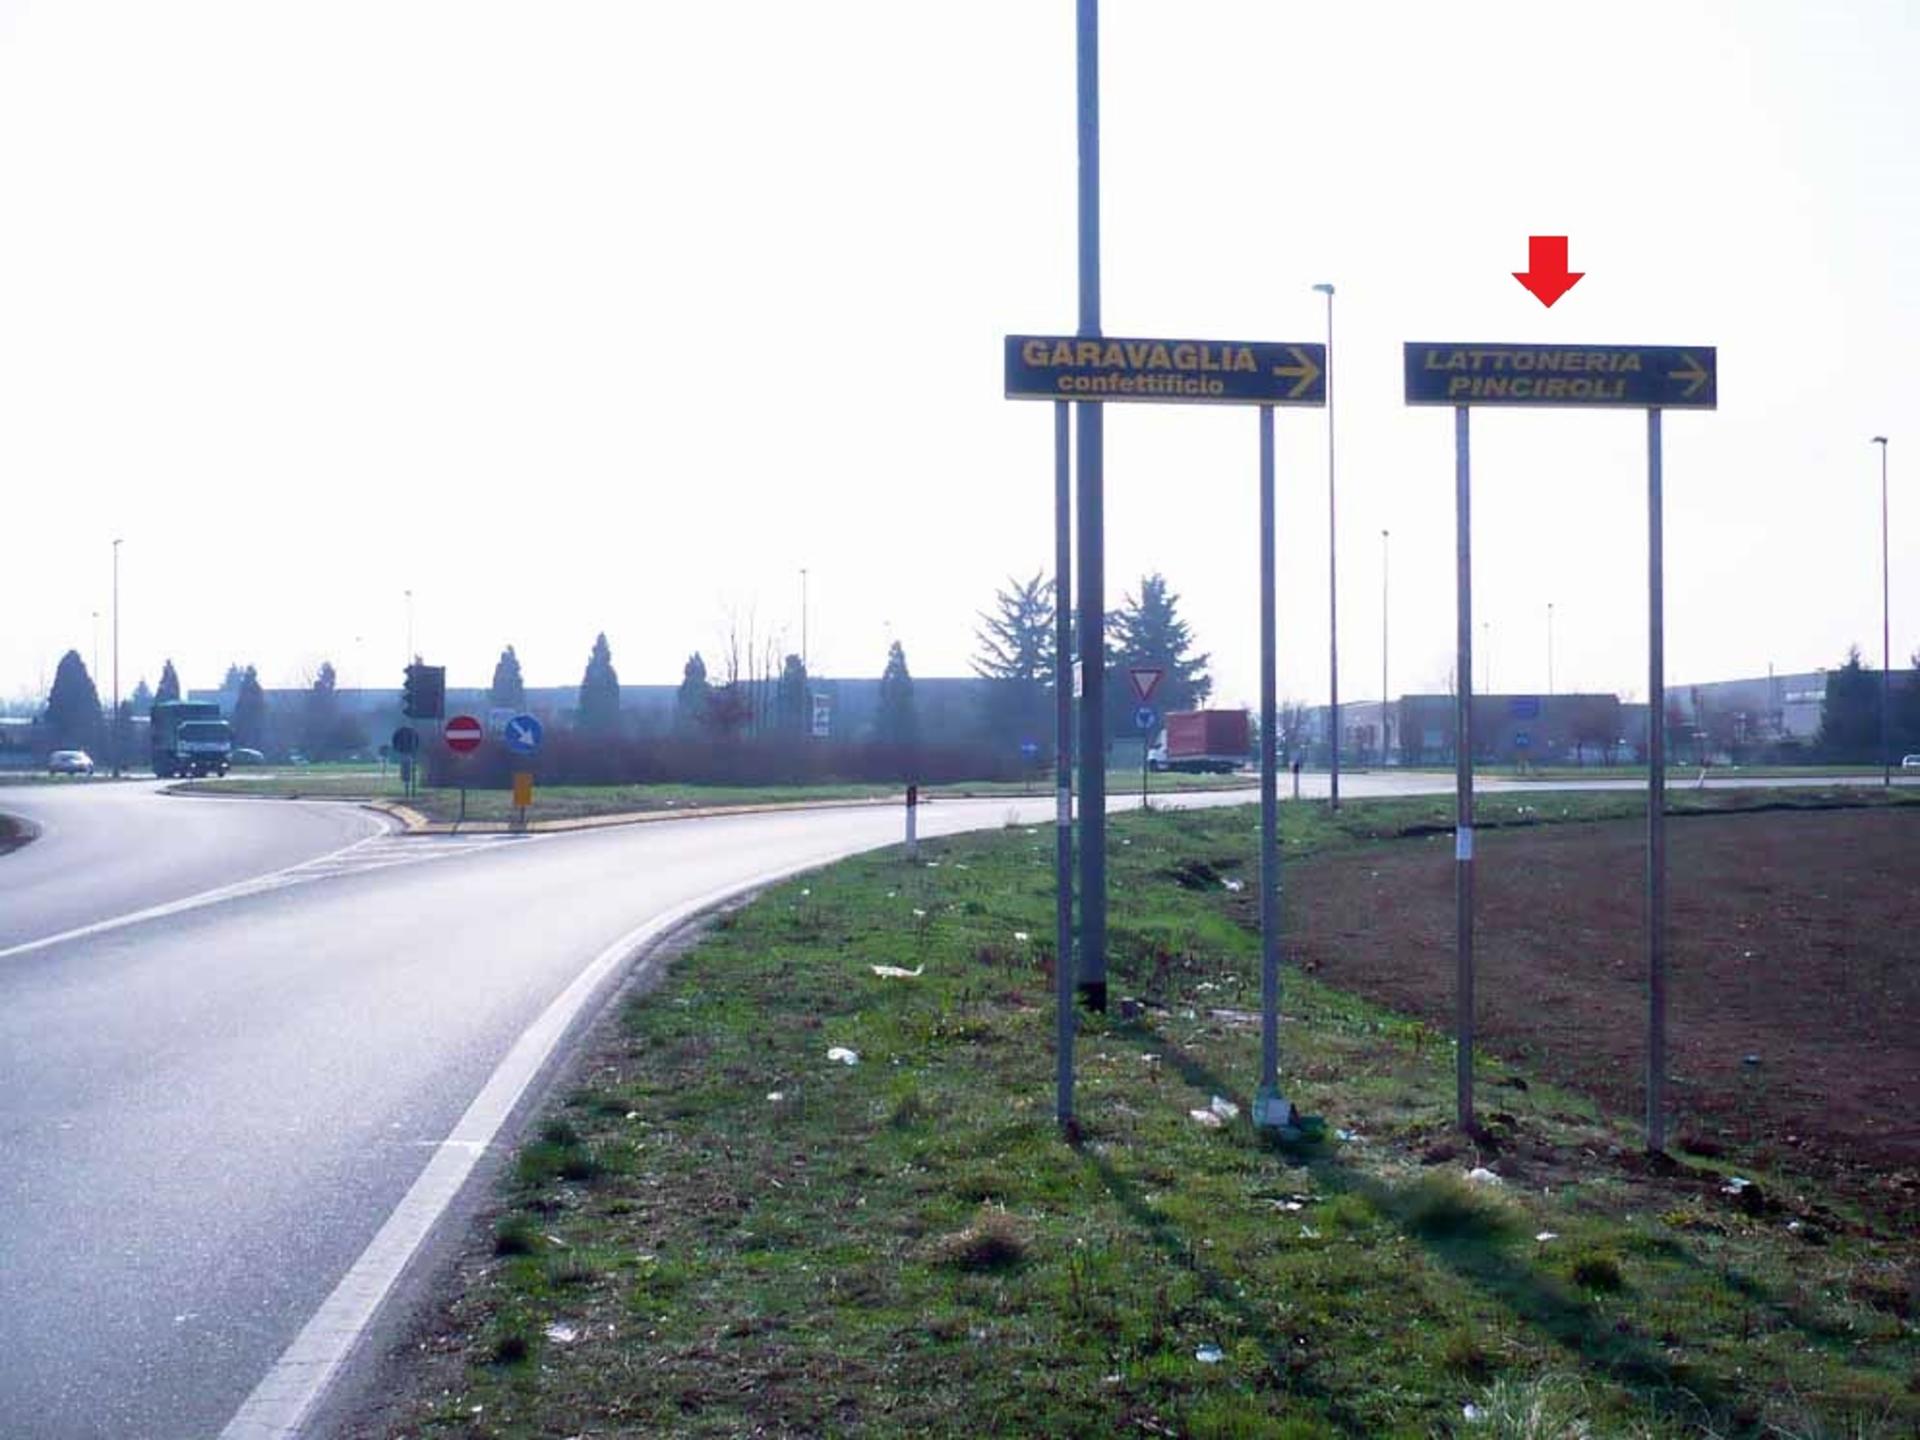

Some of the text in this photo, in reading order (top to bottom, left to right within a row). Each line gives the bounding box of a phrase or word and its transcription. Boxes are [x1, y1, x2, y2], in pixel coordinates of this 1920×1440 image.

[1022, 340, 1257, 372] GARAVAGLIA
[1426, 351, 1641, 372] LATTONERIA
[1057, 374, 1224, 395] confettificio
[1449, 377, 1626, 398] PINCIROLI
